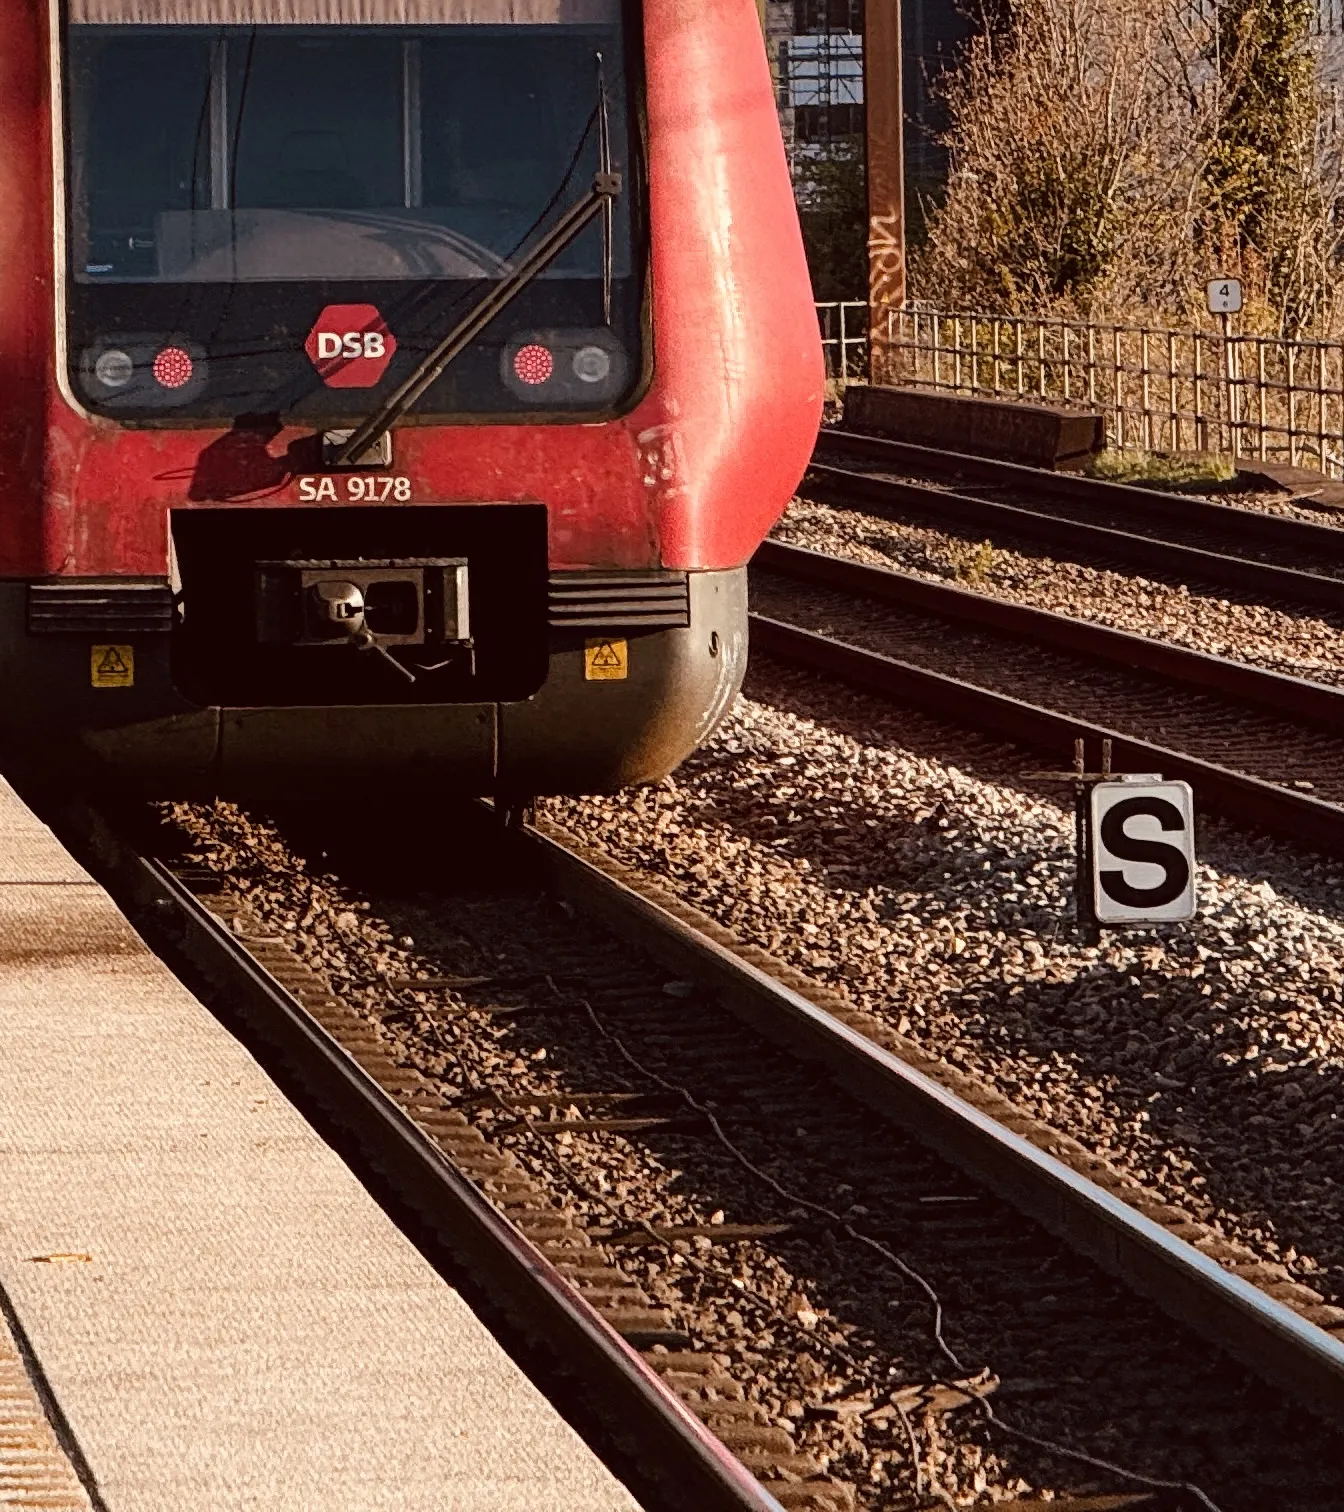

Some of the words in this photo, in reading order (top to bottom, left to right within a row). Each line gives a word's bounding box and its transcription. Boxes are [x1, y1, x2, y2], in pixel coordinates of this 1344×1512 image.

[1219, 283, 1230, 297] 4
[318, 332, 385, 358] DSB
[299, 477, 338, 501] SA
[347, 477, 411, 502] 9178
[1099, 796, 1190, 909] S
